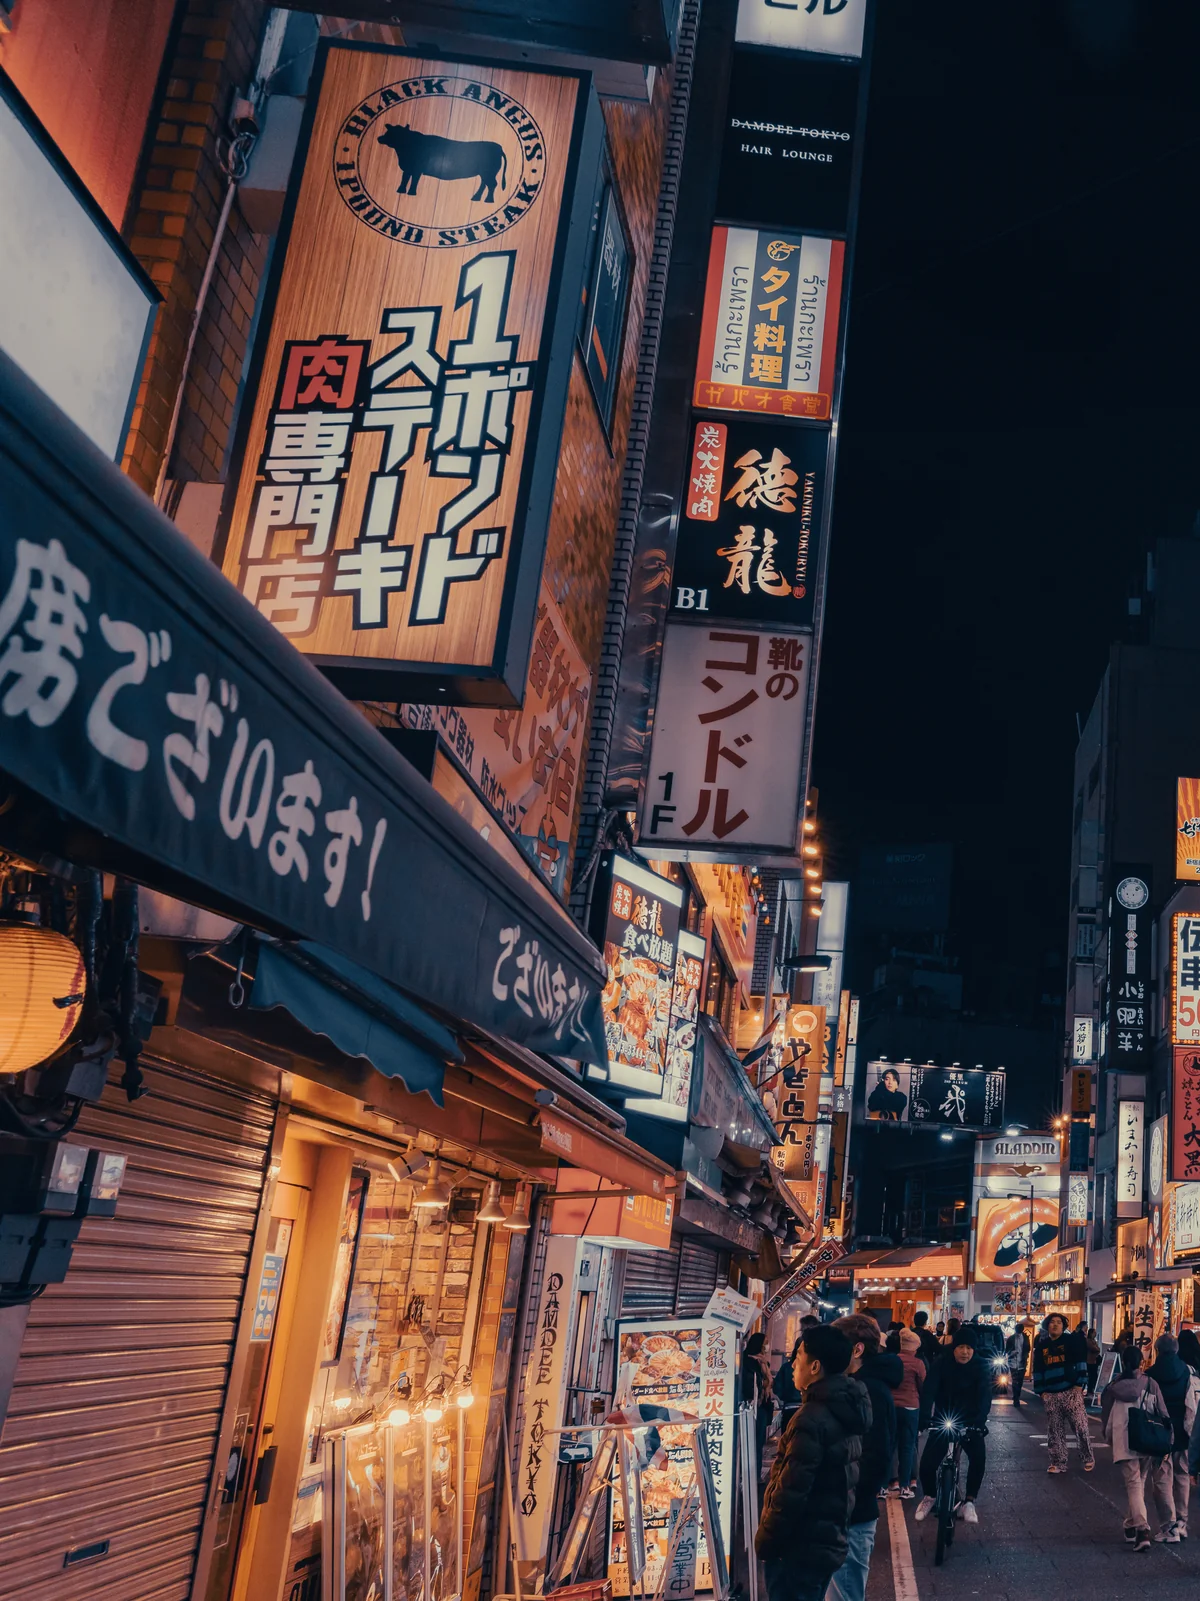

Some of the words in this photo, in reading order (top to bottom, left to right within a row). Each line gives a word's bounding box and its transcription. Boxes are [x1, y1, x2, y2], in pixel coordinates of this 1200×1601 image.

[343, 79, 450, 138] BLACK
[460, 83, 543, 162] ANGUS
[741, 144, 773, 156] HAIR
[782, 149, 833, 163] LOUNGE
[800, 127, 850, 141] TOKYO
[438, 178, 540, 246] STEAK
[749, 266, 791, 384] タイ料理
[705, 387, 821, 415] ガパオ食堂
[332, 309, 444, 626] ステーキ
[412, 253, 528, 622] 1ポンド
[240, 341, 366, 636] 肉専門店
[675, 586, 709, 611] B1
[766, 637, 803, 701] 靴の
[681, 632, 760, 839] コンドル
[650, 772, 677, 834] 1F
[622, 923, 674, 967] 食べ放題
[1116, 981, 1137, 1052] 小肥羊
[1191, 1029, 1200, 1038] 円
[994, 1141, 1057, 1156] ALADDIN
[535, 1272, 563, 1385] DAMDEE
[521, 1398, 549, 1516] TOKYO
